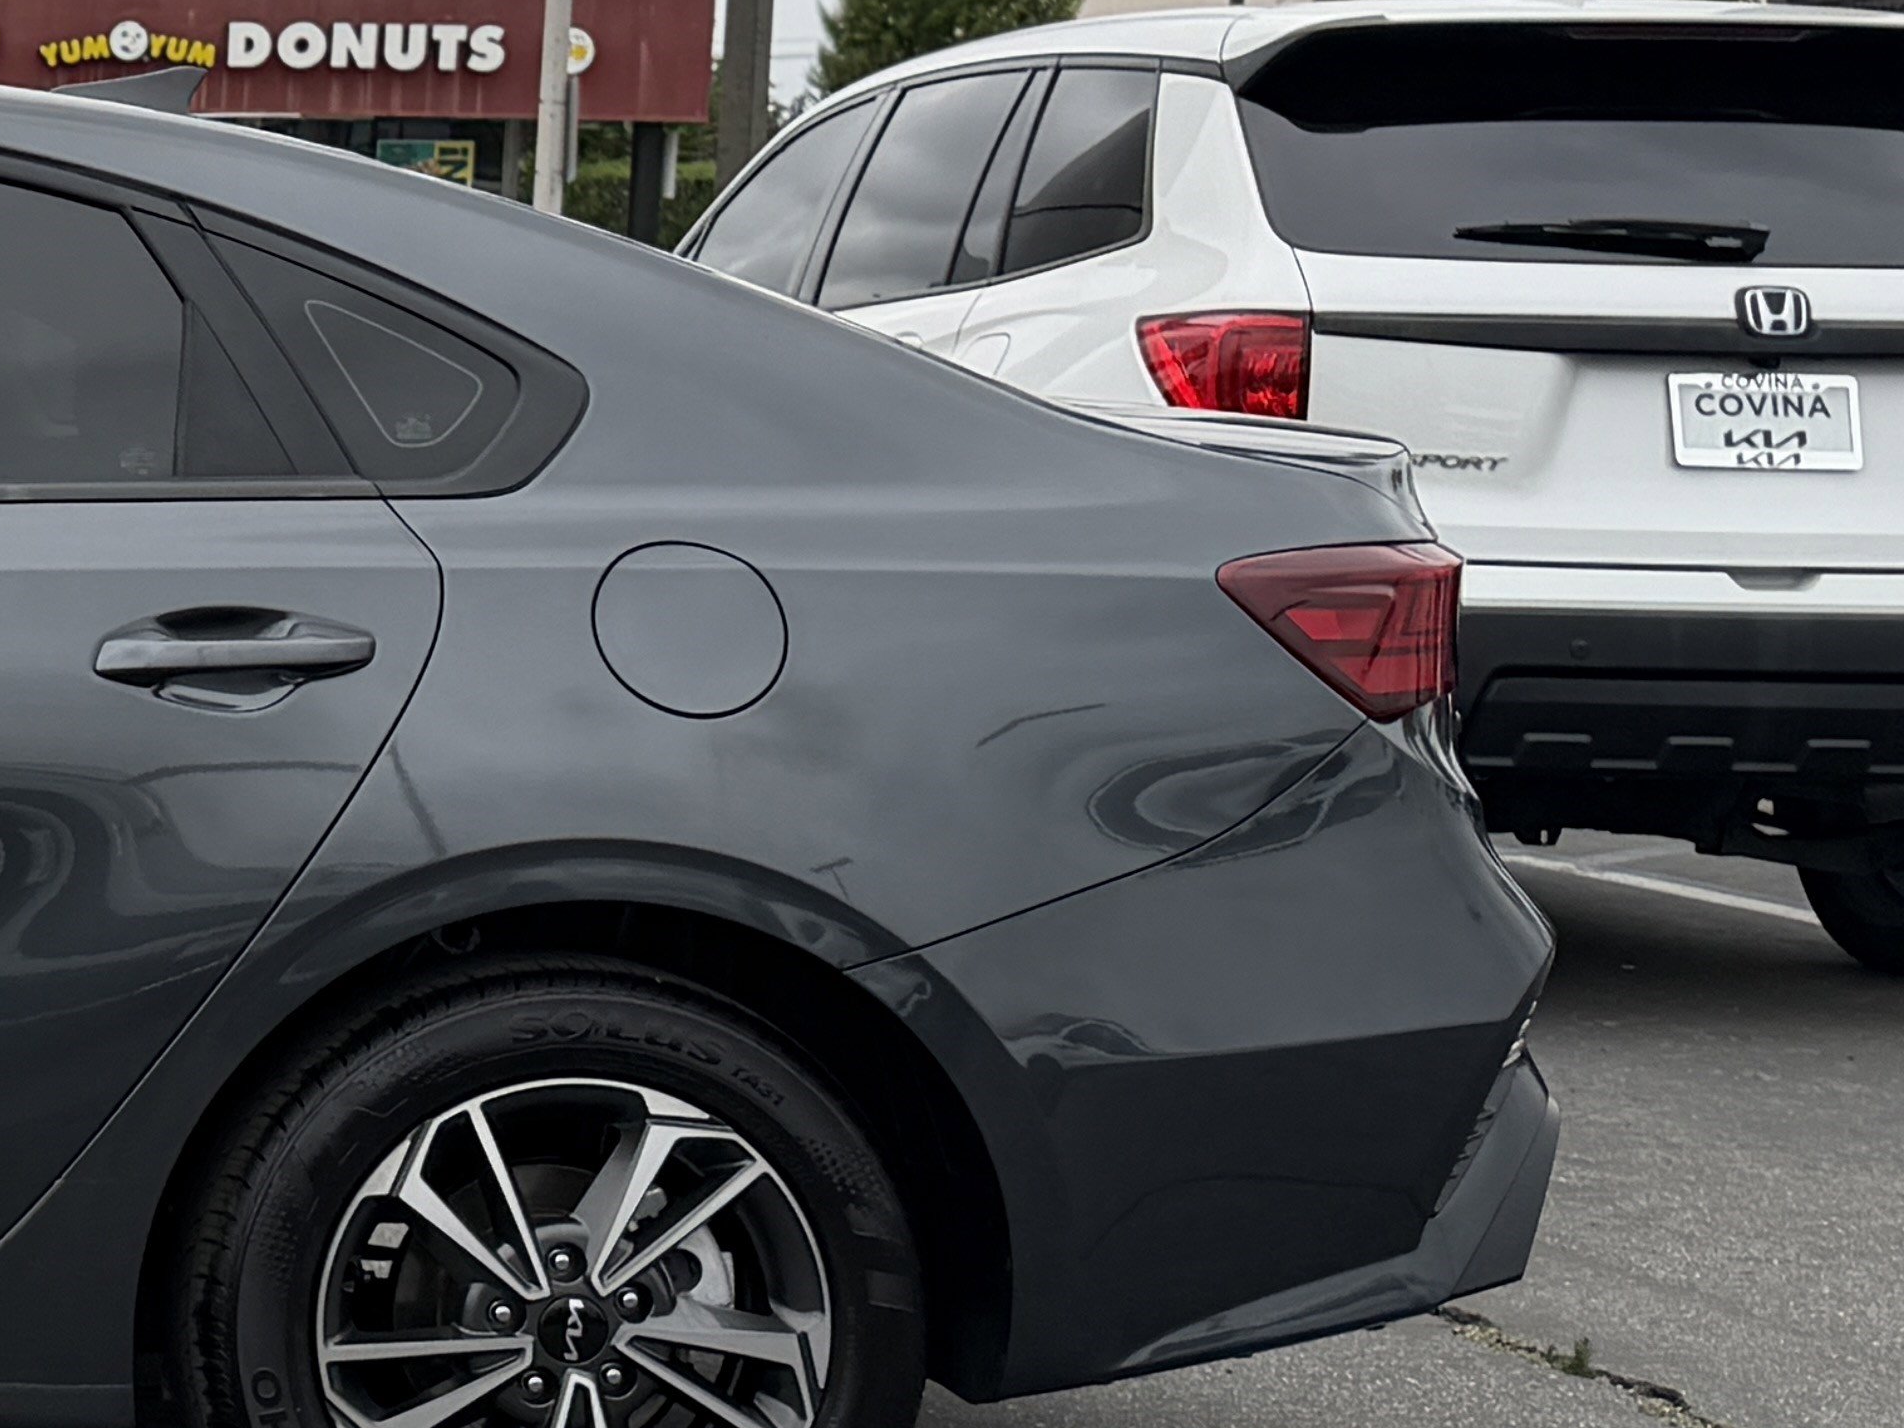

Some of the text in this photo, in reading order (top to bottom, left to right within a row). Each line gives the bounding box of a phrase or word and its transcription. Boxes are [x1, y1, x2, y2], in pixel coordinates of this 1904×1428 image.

[39, 21, 507, 73] YUM YUM DONUTS
[1721, 372, 1805, 391] COVINA
[1694, 392, 1832, 419] COVINA
